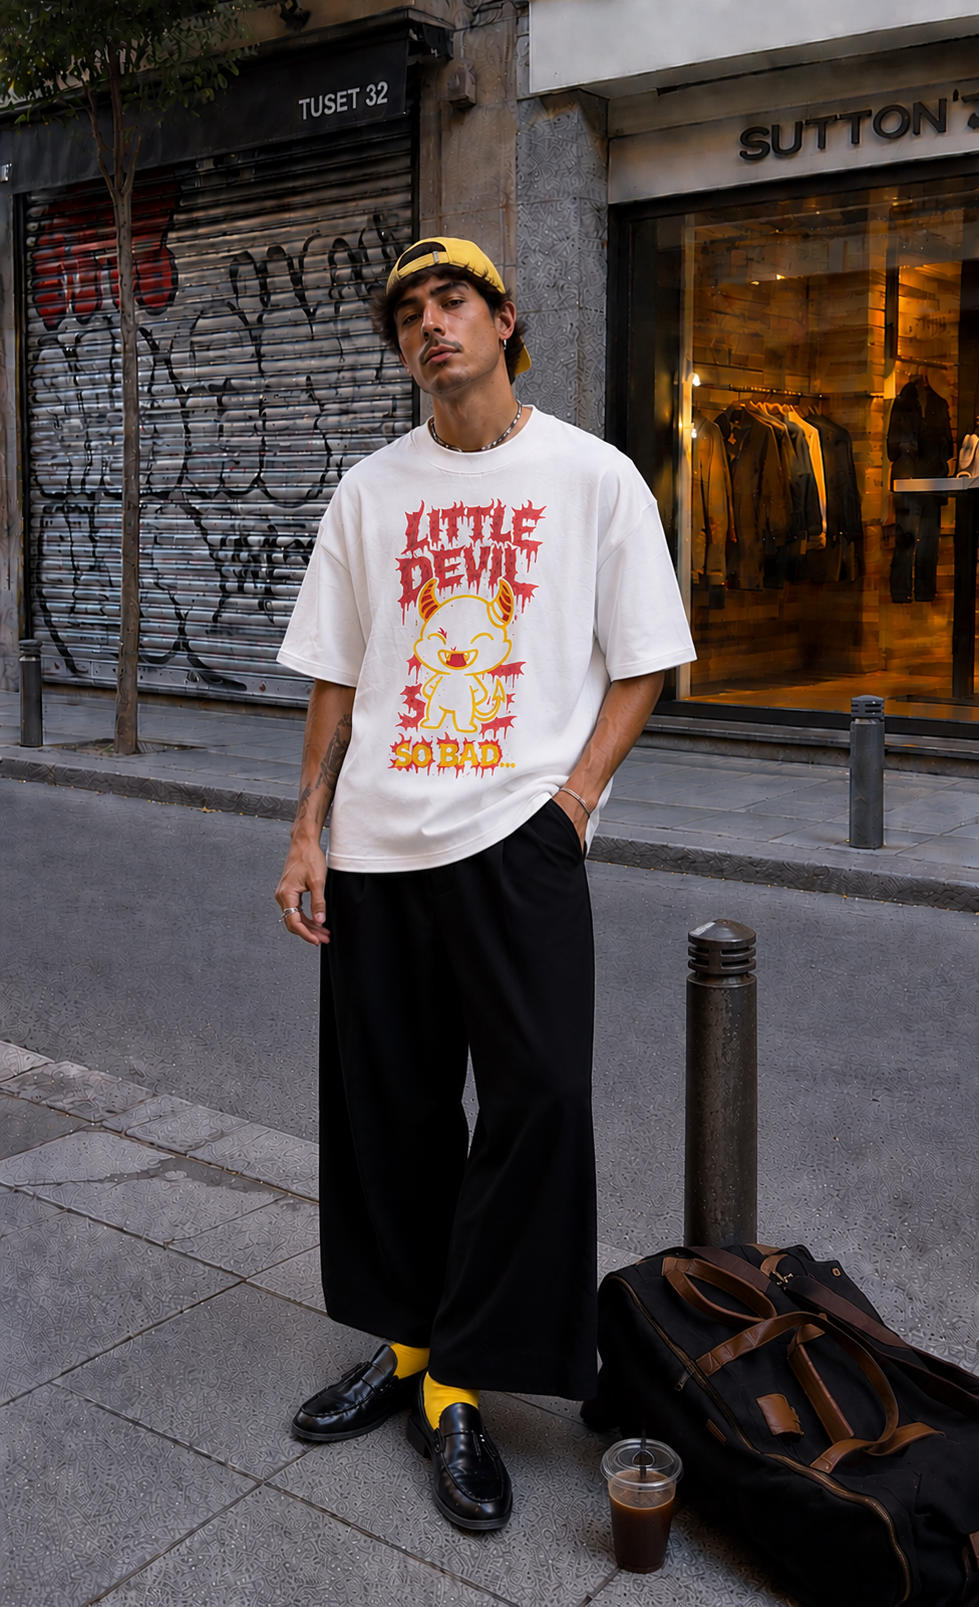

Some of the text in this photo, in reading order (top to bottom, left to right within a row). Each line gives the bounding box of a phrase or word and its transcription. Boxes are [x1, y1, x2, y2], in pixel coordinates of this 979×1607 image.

[299, 81, 388, 120] TUSET 32
[402, 499, 546, 561] LITTLE
[396, 544, 539, 612] DEVIL
[391, 738, 434, 771] SO
